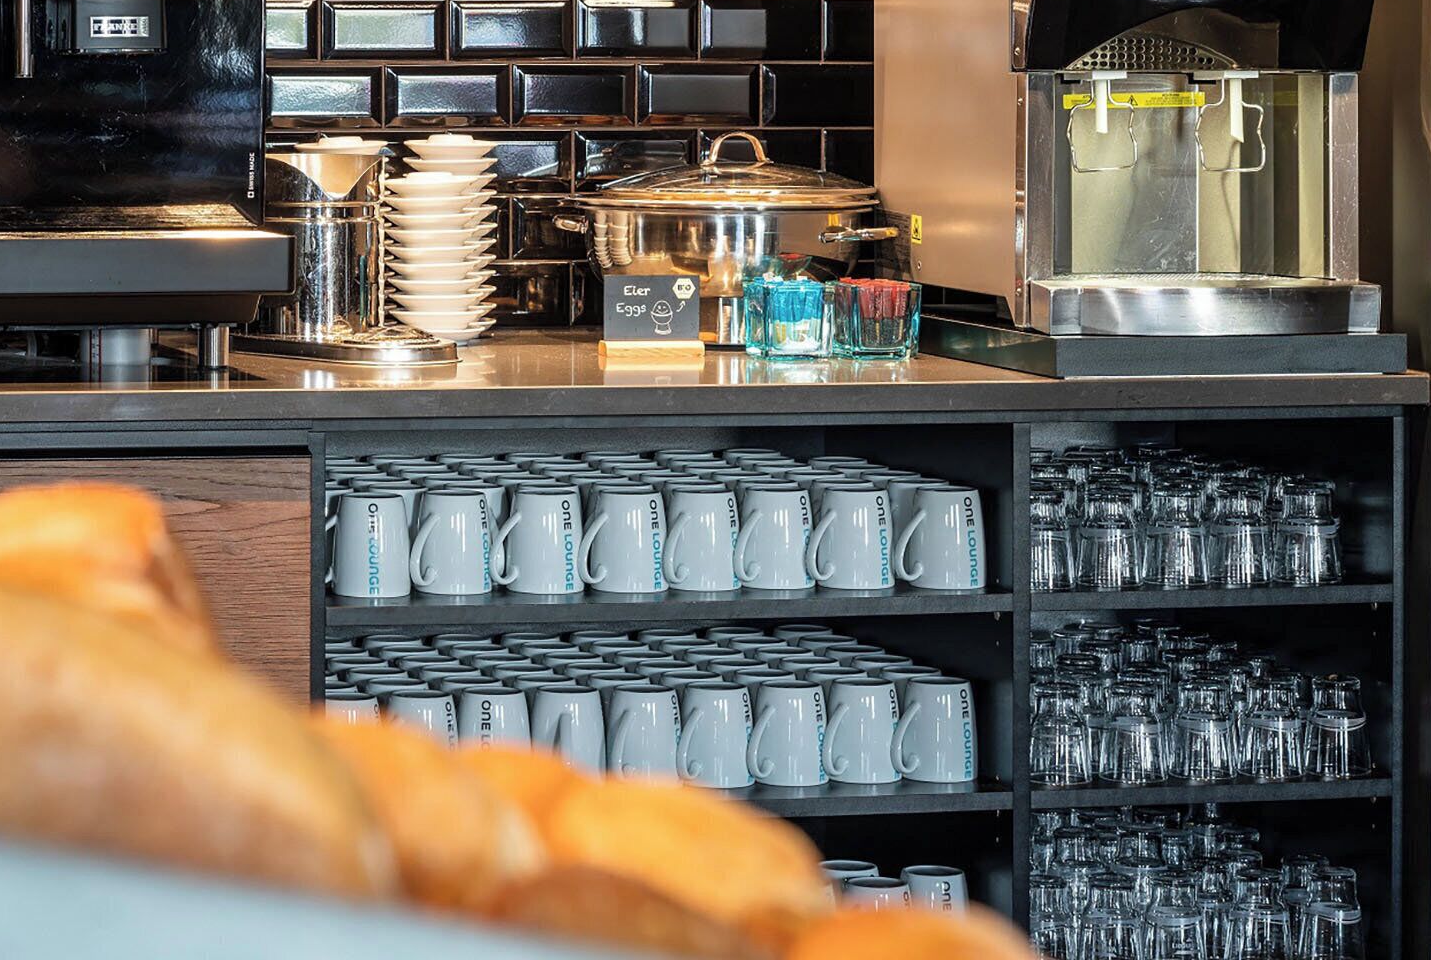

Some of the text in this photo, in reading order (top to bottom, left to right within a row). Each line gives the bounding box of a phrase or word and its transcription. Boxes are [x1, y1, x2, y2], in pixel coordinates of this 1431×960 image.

[623, 285, 651, 296] Eier
[615, 302, 647, 317] Eggs
[479, 499, 488, 529] ONE
[727, 497, 737, 528] ONE
[799, 495, 809, 526] ONE
[561, 499, 575, 591] ONE LOUNGE
[649, 499, 662, 590] ONE LOUNGE
[876, 495, 889, 586] ONE LOUNGE
[963, 496, 978, 587] ONE LOUNGE
[368, 537, 379, 595] LOUNGE
[481, 700, 492, 731] ONE
[671, 694, 680, 725] ONE
[741, 692, 752, 722] ONE
[813, 691, 823, 722] ONE
[889, 688, 898, 719] ONE
[960, 688, 972, 780] ONE LOUNGE
